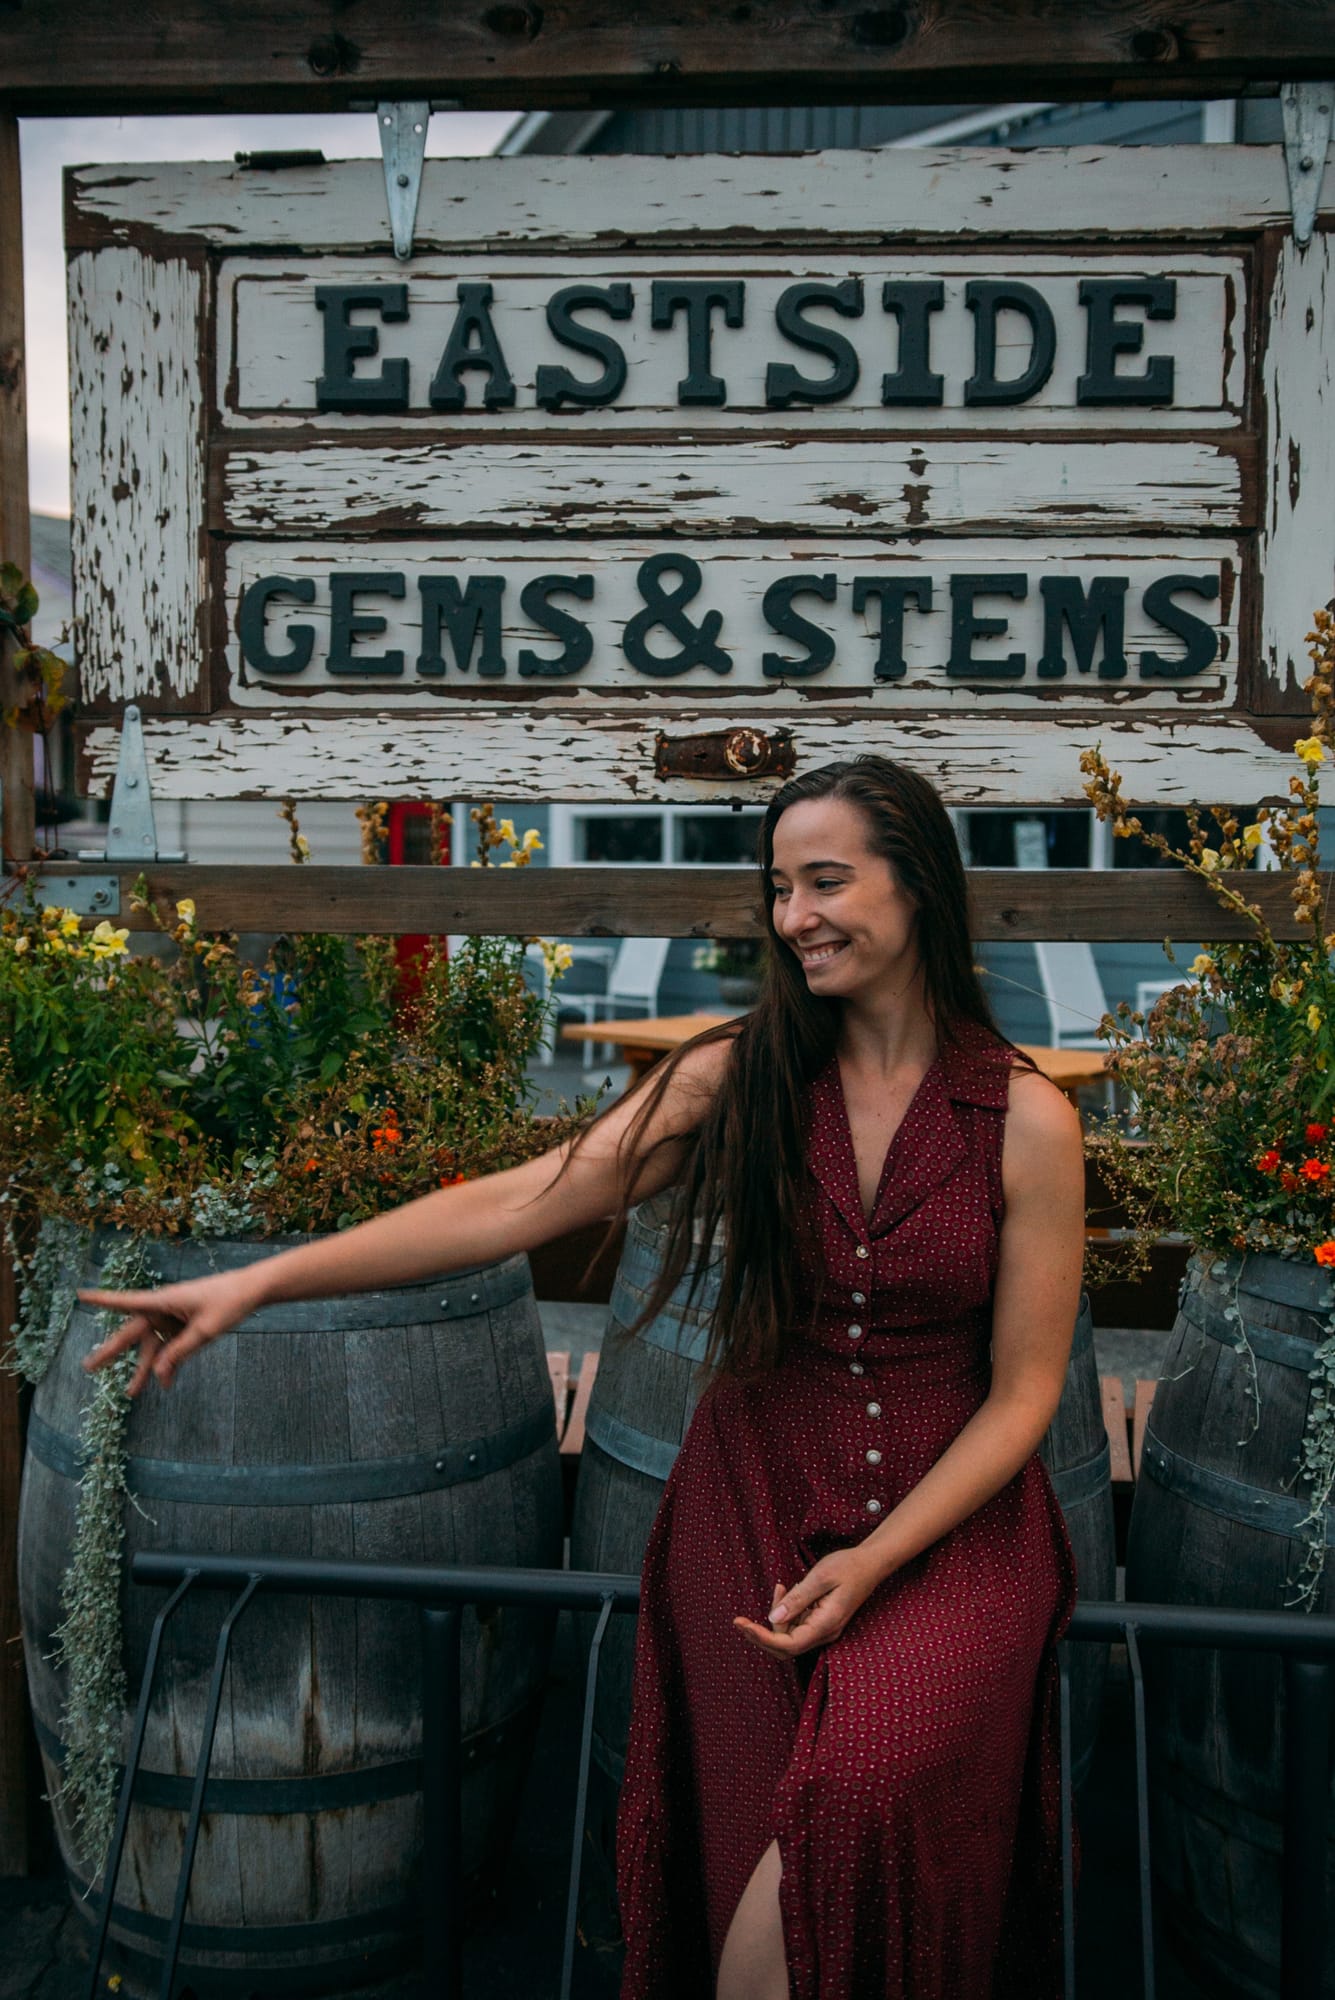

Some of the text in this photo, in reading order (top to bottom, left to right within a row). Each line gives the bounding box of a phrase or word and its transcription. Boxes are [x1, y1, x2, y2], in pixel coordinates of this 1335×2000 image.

[315, 278, 1177, 409] EASTSIDE
[241, 551, 1221, 680] GEMS & STEMS
